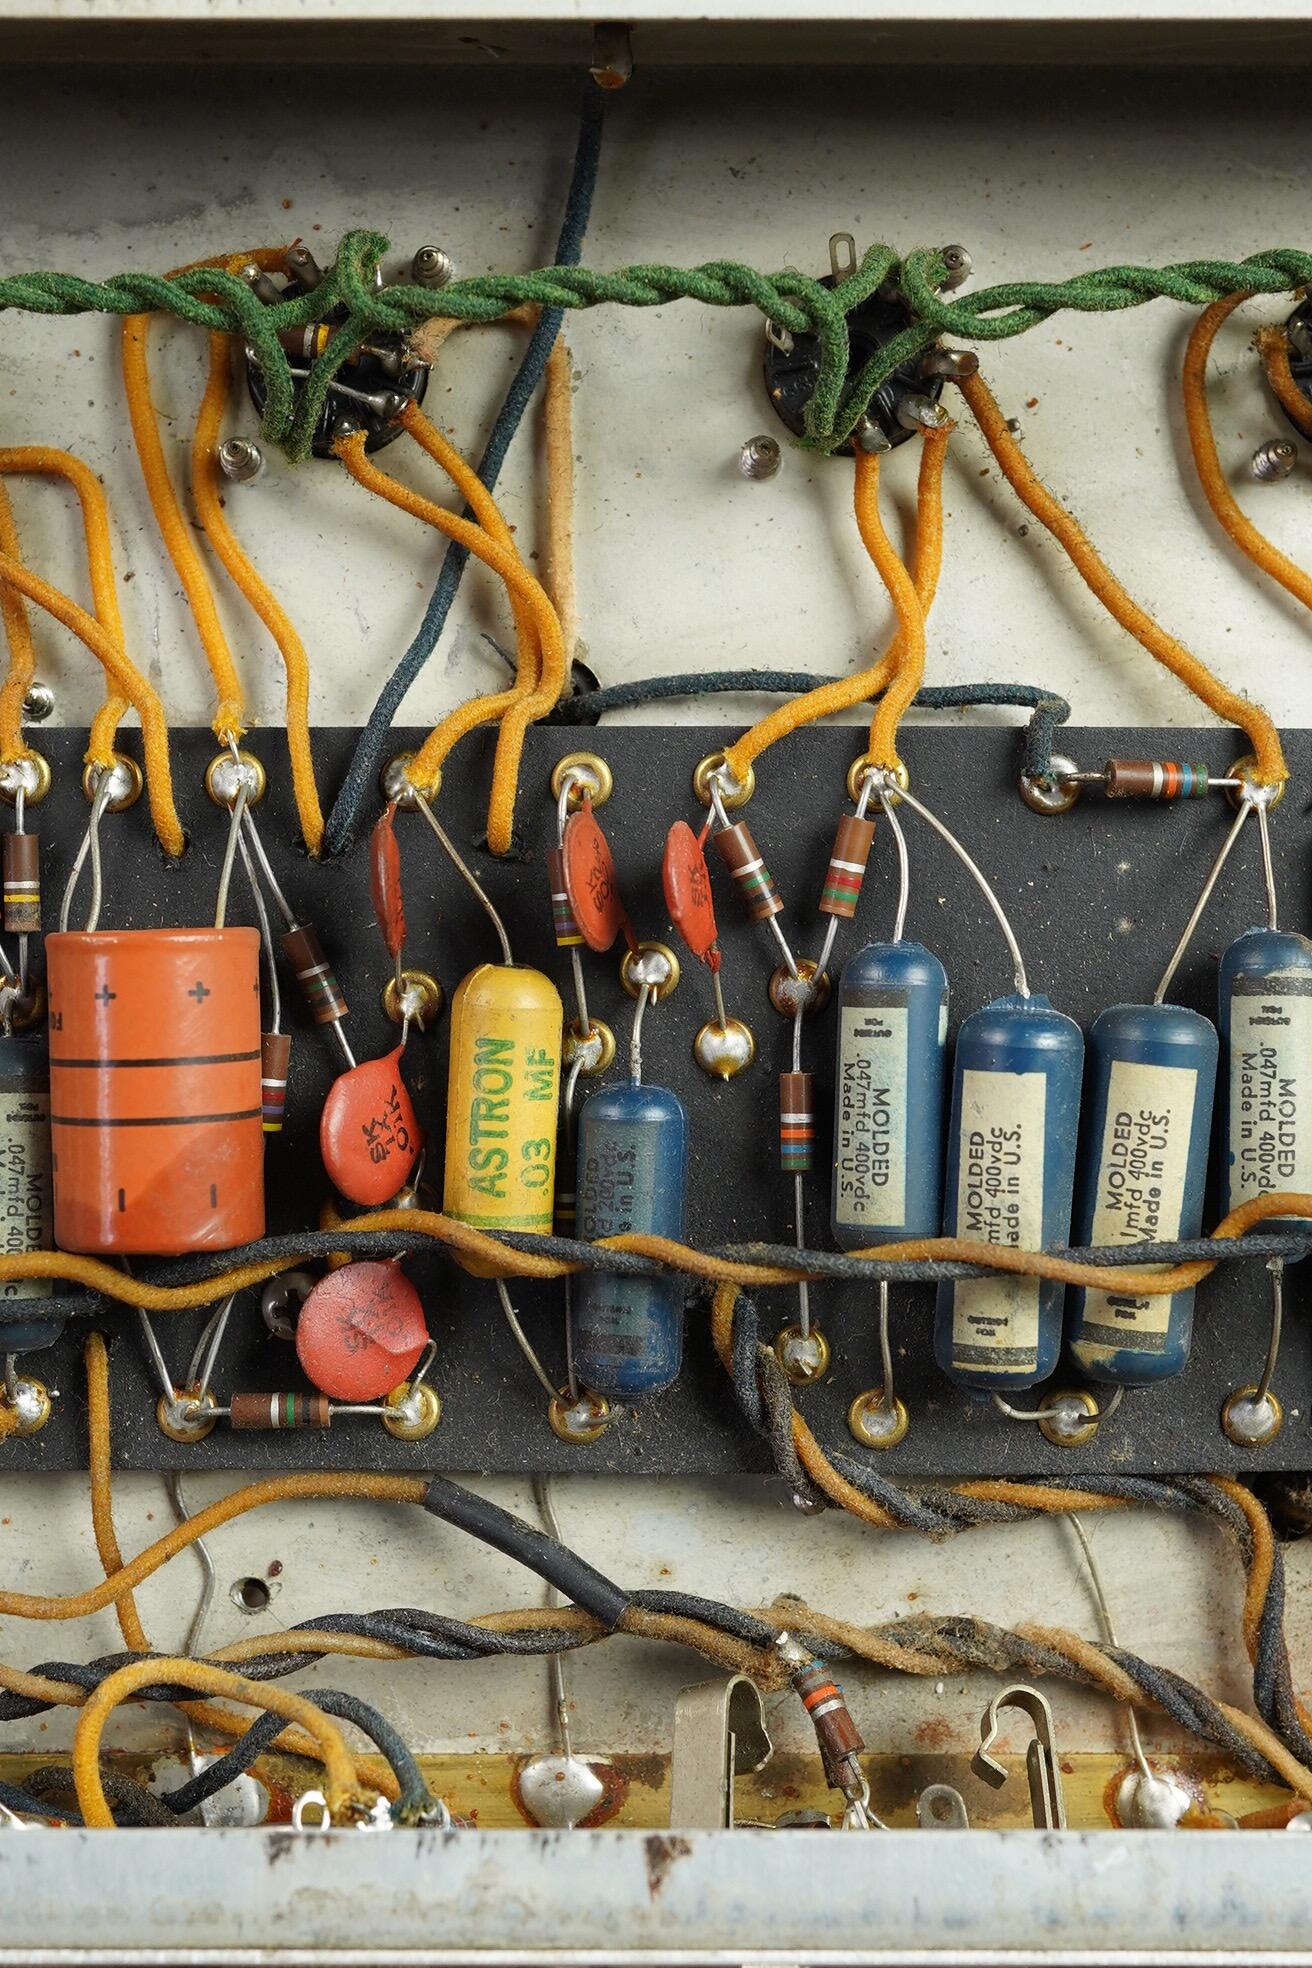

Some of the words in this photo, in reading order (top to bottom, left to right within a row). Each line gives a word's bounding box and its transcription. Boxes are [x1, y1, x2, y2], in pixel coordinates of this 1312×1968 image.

[524, 1048, 555, 1101] MF
[842, 1063, 856, 1121] Made
[855, 1053, 871, 1133] .047mfd
[1241, 1053, 1257, 1111] Made
[1259, 1042, 1277, 1122] .047mfd
[468, 1037, 515, 1198] ASTRON
[841, 1130, 855, 1148] in
[872, 1088, 890, 1187] MOLDED
[1004, 1123, 1022, 1165] U.S.
[1128, 1109, 1153, 1180] 400vdc
[1150, 1109, 1171, 1150] U.S.
[1241, 1120, 1257, 1138] in
[1278, 1078, 1296, 1178] MOLDED
[7, 1137, 26, 1218] .047mfd
[520, 1138, 551, 1196] .03
[840, 1157, 854, 1198] U.S.
[853, 1140, 870, 1213] 400vdc
[967, 1130, 984, 1231] MOLDED
[985, 1126, 1003, 1200] 400vdc
[1003, 1176, 1020, 1195] in
[1106, 1111, 1133, 1211] MOLDED
[1145, 1160, 1164, 1179] in
[1240, 1149, 1257, 1189] U.S.
[26, 1173, 43, 1252] MOLDE
